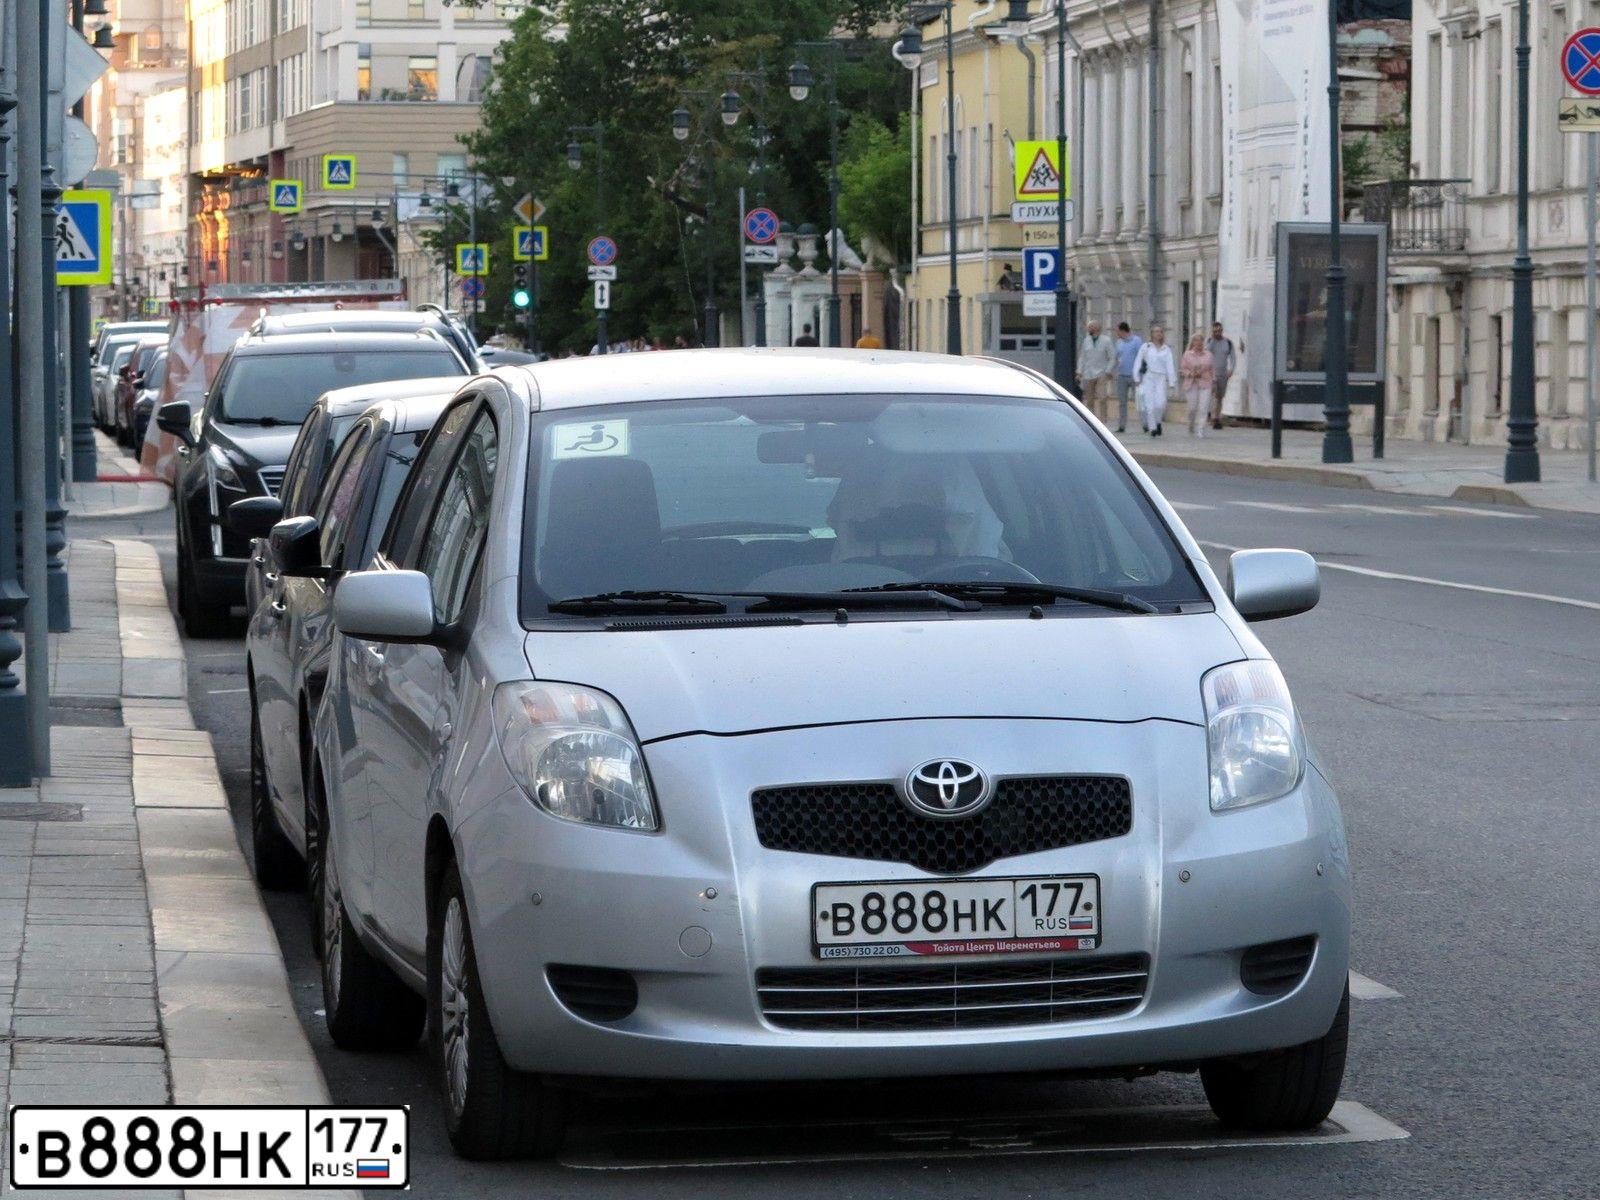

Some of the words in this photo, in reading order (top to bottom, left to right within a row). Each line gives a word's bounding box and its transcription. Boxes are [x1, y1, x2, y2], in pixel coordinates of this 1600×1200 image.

[1019, 205, 1060, 217] ГЛУХИ
[1033, 231, 1048, 240] 150
[1033, 252, 1055, 288] P
[831, 890, 1007, 936] В888НК
[1020, 882, 1084, 917] 177
[1036, 917, 1067, 930] RUS
[824, 947, 851, 957] (495)
[853, 947, 871, 956] 730
[873, 946, 885, 955] 22
[886, 946, 900, 955] 00
[932, 943, 965, 953] Тойота
[966, 942, 995, 952] Центр
[996, 940, 1061, 950] Шереметьево
